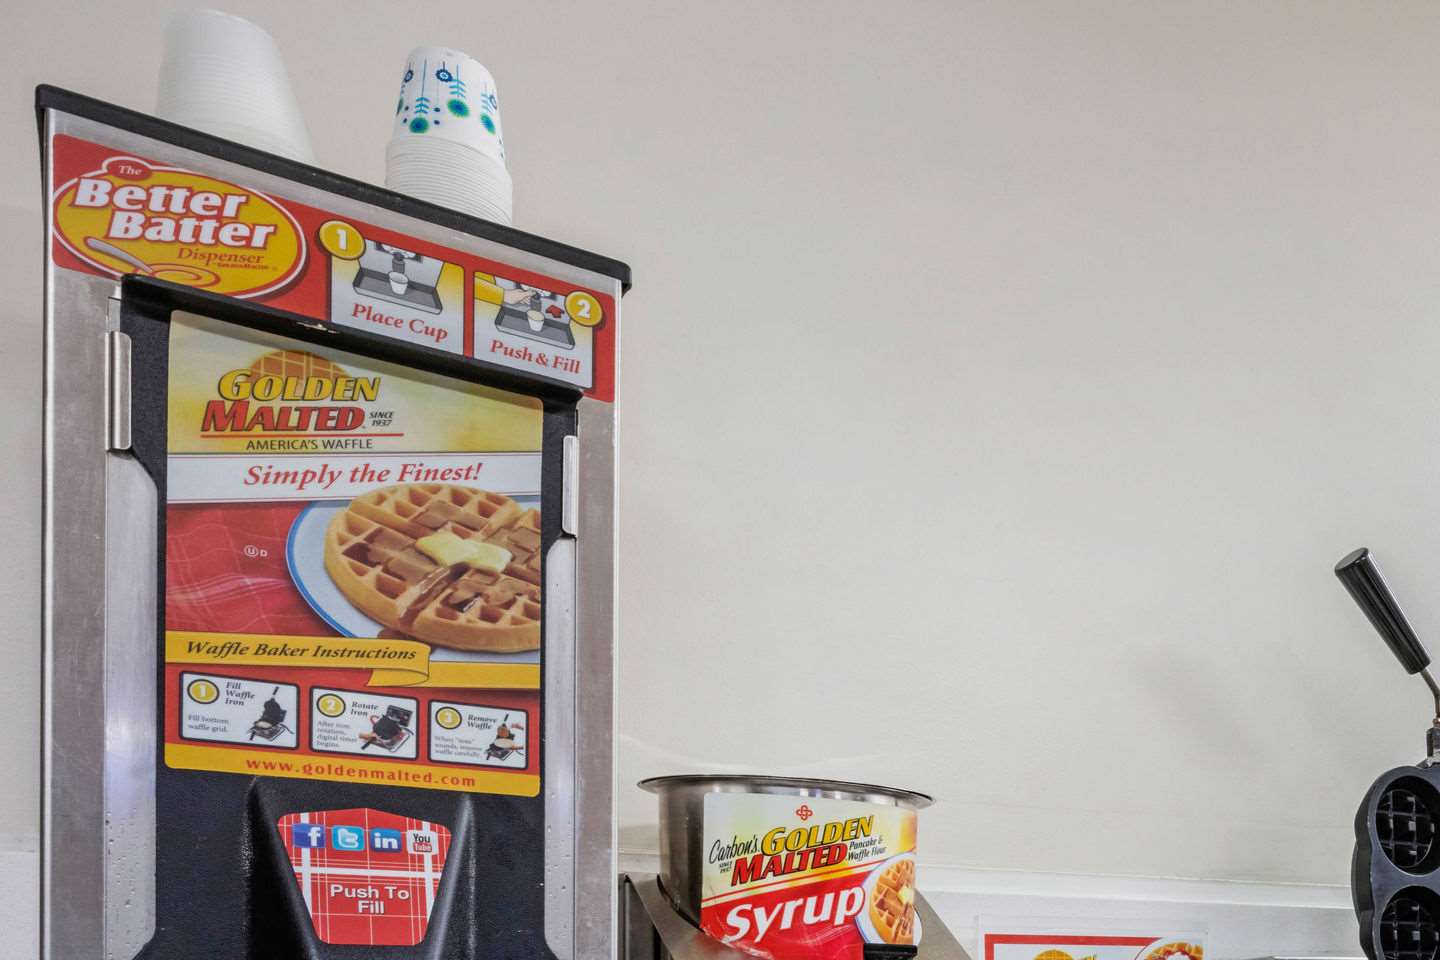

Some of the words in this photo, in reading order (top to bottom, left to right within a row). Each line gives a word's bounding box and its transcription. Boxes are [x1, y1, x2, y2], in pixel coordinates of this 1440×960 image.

[118, 165, 143, 176] The
[74, 177, 247, 218] Better
[108, 210, 275, 248] Batter
[335, 228, 348, 250] 1
[176, 246, 265, 268] Dispenser
[575, 300, 591, 319] 2
[351, 303, 404, 330] Place
[409, 319, 449, 343] Cup
[490, 339, 533, 363] Push
[535, 351, 549, 367] &
[552, 356, 581, 375] Fill
[217, 369, 382, 402] GOLDEN
[199, 399, 366, 433] MALTED
[369, 411, 395, 420] SINCE
[245, 438, 319, 451] AMERICA'S
[322, 438, 374, 450] WAFFLE
[243, 463, 344, 490] Simply
[350, 463, 391, 484] the
[396, 462, 484, 482] Finest!
[186, 640, 250, 659] Waffle
[254, 643, 309, 658] Baker
[312, 644, 417, 660] Instructions
[225, 681, 242, 690] Fill
[225, 689, 256, 700] Waffle
[224, 698, 245, 707] Iron
[351, 701, 380, 711] Rotate
[350, 708, 369, 717] Iron
[467, 721, 492, 730] Waffle
[246, 758, 477, 787] www.goldenmalted.com
[373, 832, 399, 849] in
[413, 833, 431, 844] You
[708, 833, 759, 865] Carbon's
[761, 815, 876, 856] GOLDEN
[731, 842, 849, 887] MALTED
[847, 849, 871, 861] Waffle
[330, 884, 380, 899] Push
[384, 885, 410, 900] To
[357, 900, 386, 915] Fill
[721, 886, 866, 944] Syrup
